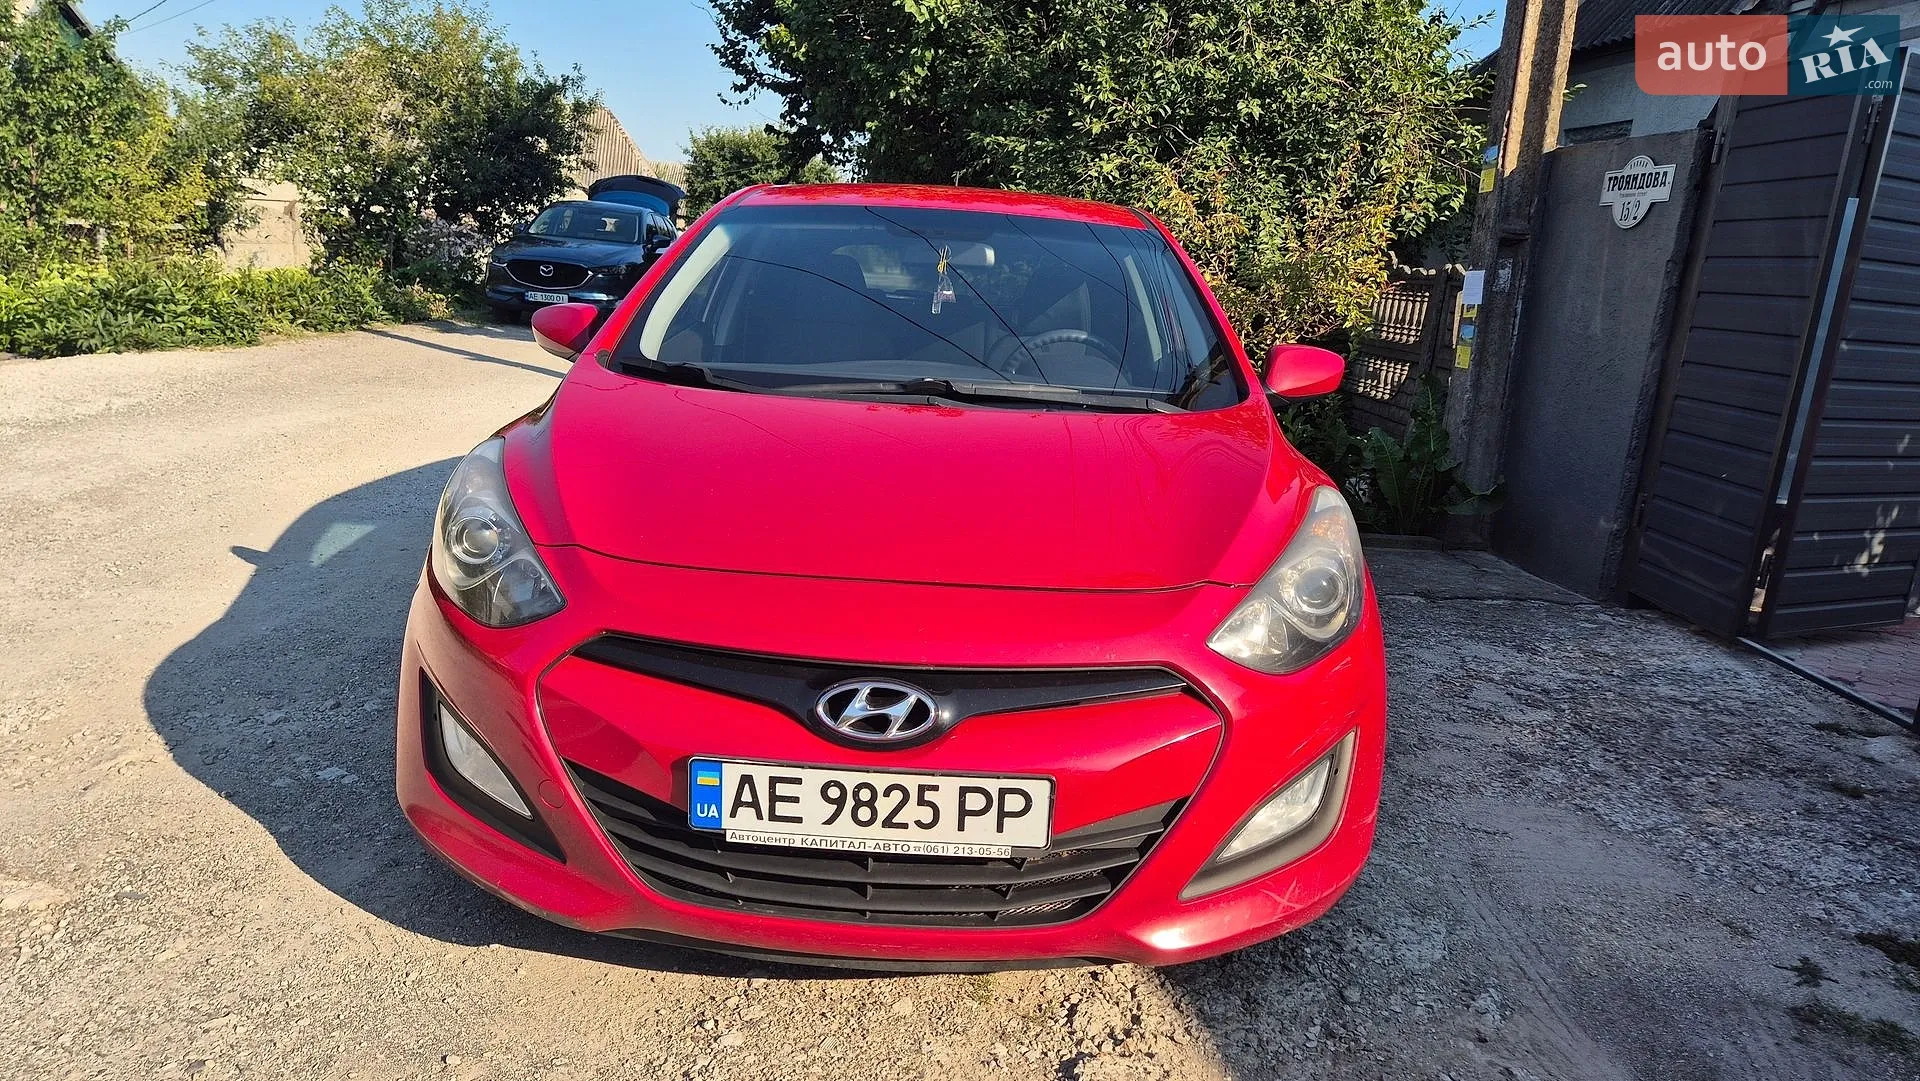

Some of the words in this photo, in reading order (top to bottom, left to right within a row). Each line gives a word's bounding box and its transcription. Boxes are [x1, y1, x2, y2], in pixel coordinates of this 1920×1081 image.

[1607, 171, 1668, 192] ТРОЯНДОВА
[696, 803, 720, 819] UA
[729, 774, 803, 824] AE
[819, 779, 940, 830] 9825
[957, 785, 1033, 834] PP
[729, 831, 796, 846] Автоцентр
[800, 837, 911, 852] КАПИТАЛ-АВТО
[953, 845, 1011, 857] 213-05-56
